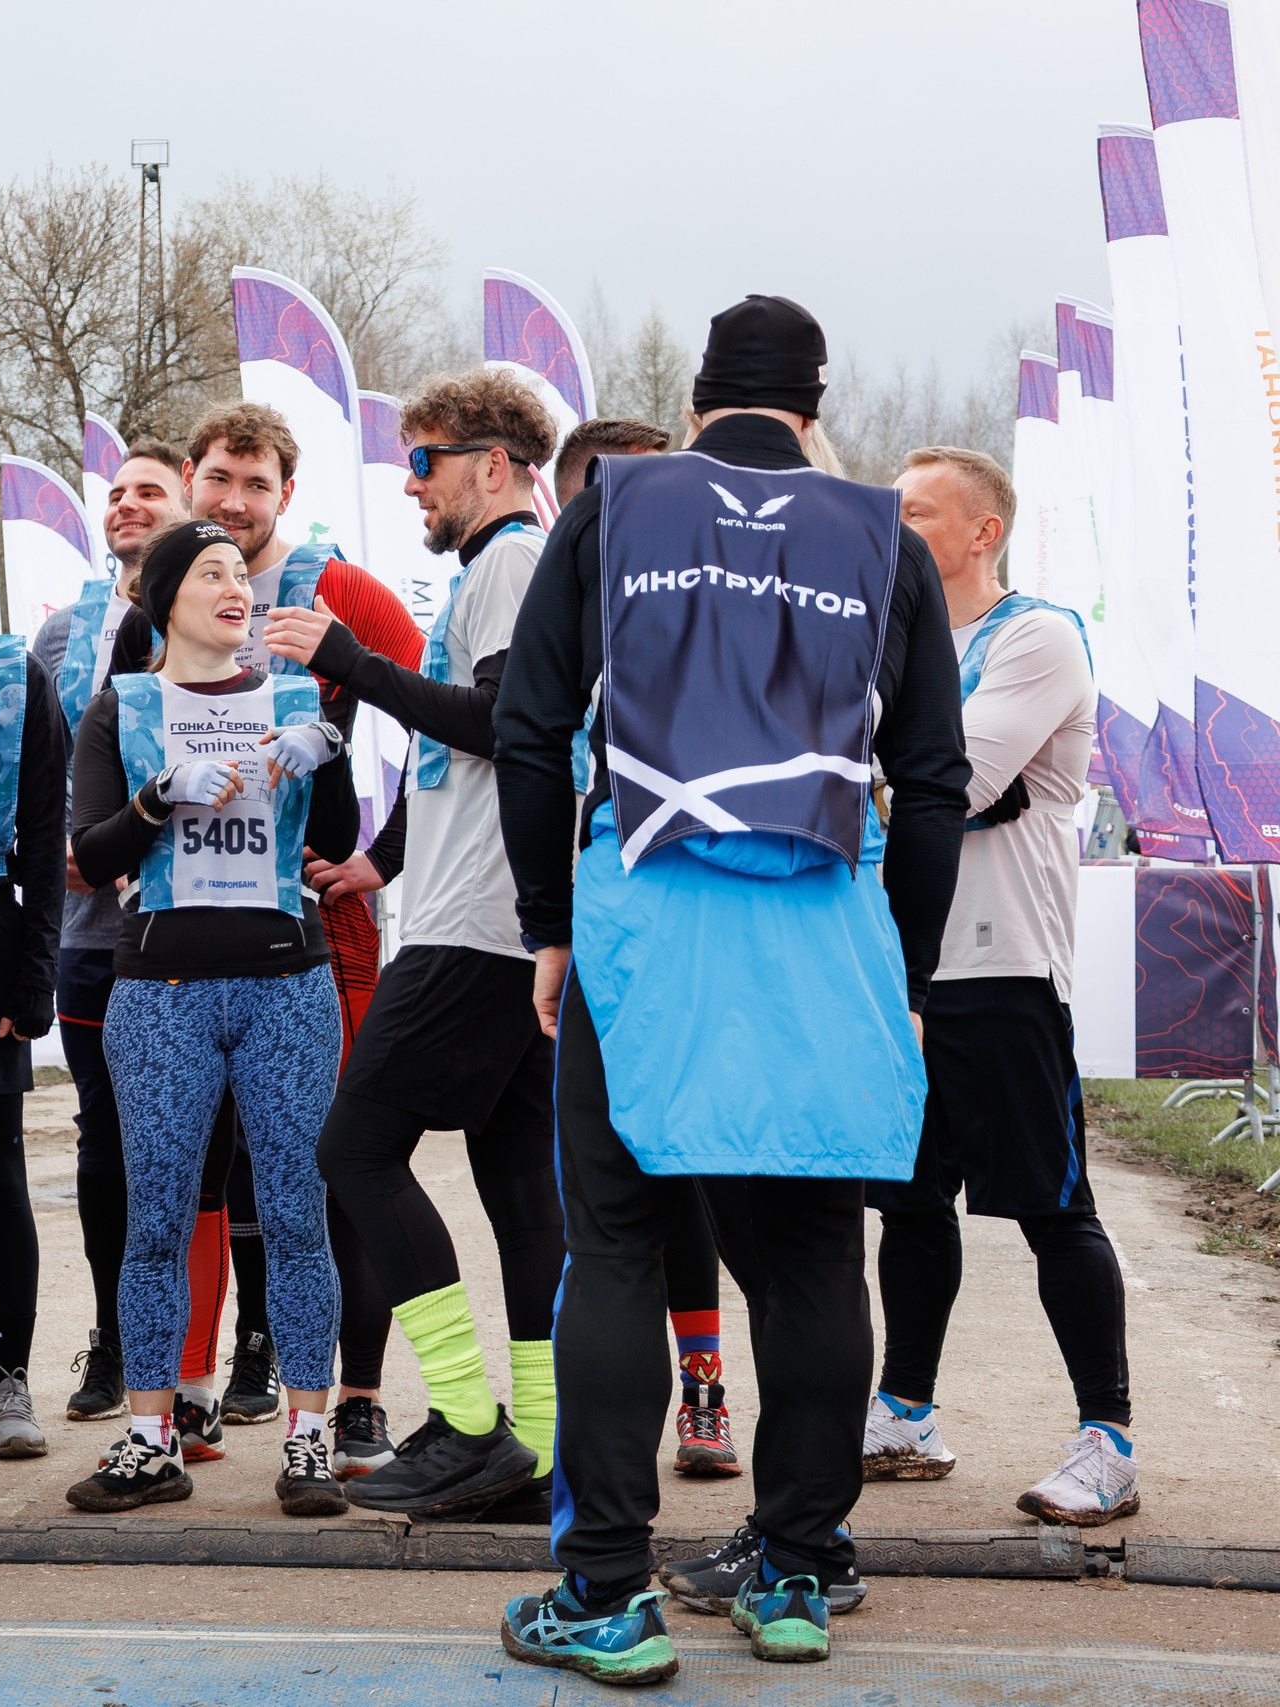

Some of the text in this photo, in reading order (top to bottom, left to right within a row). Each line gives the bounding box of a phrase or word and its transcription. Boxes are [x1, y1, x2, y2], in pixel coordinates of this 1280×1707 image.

[715, 517, 786, 532] ЛИГА ГЕРОЕВ
[623, 564, 867, 618] ИНСТРУКТОР
[170, 720, 269, 732] ГОНКА ГЕРОЕВ
[185, 738, 257, 754] Sminex
[182, 817, 268, 855] 5405
[208, 880, 258, 889] ГАЗПРОМБАНК
